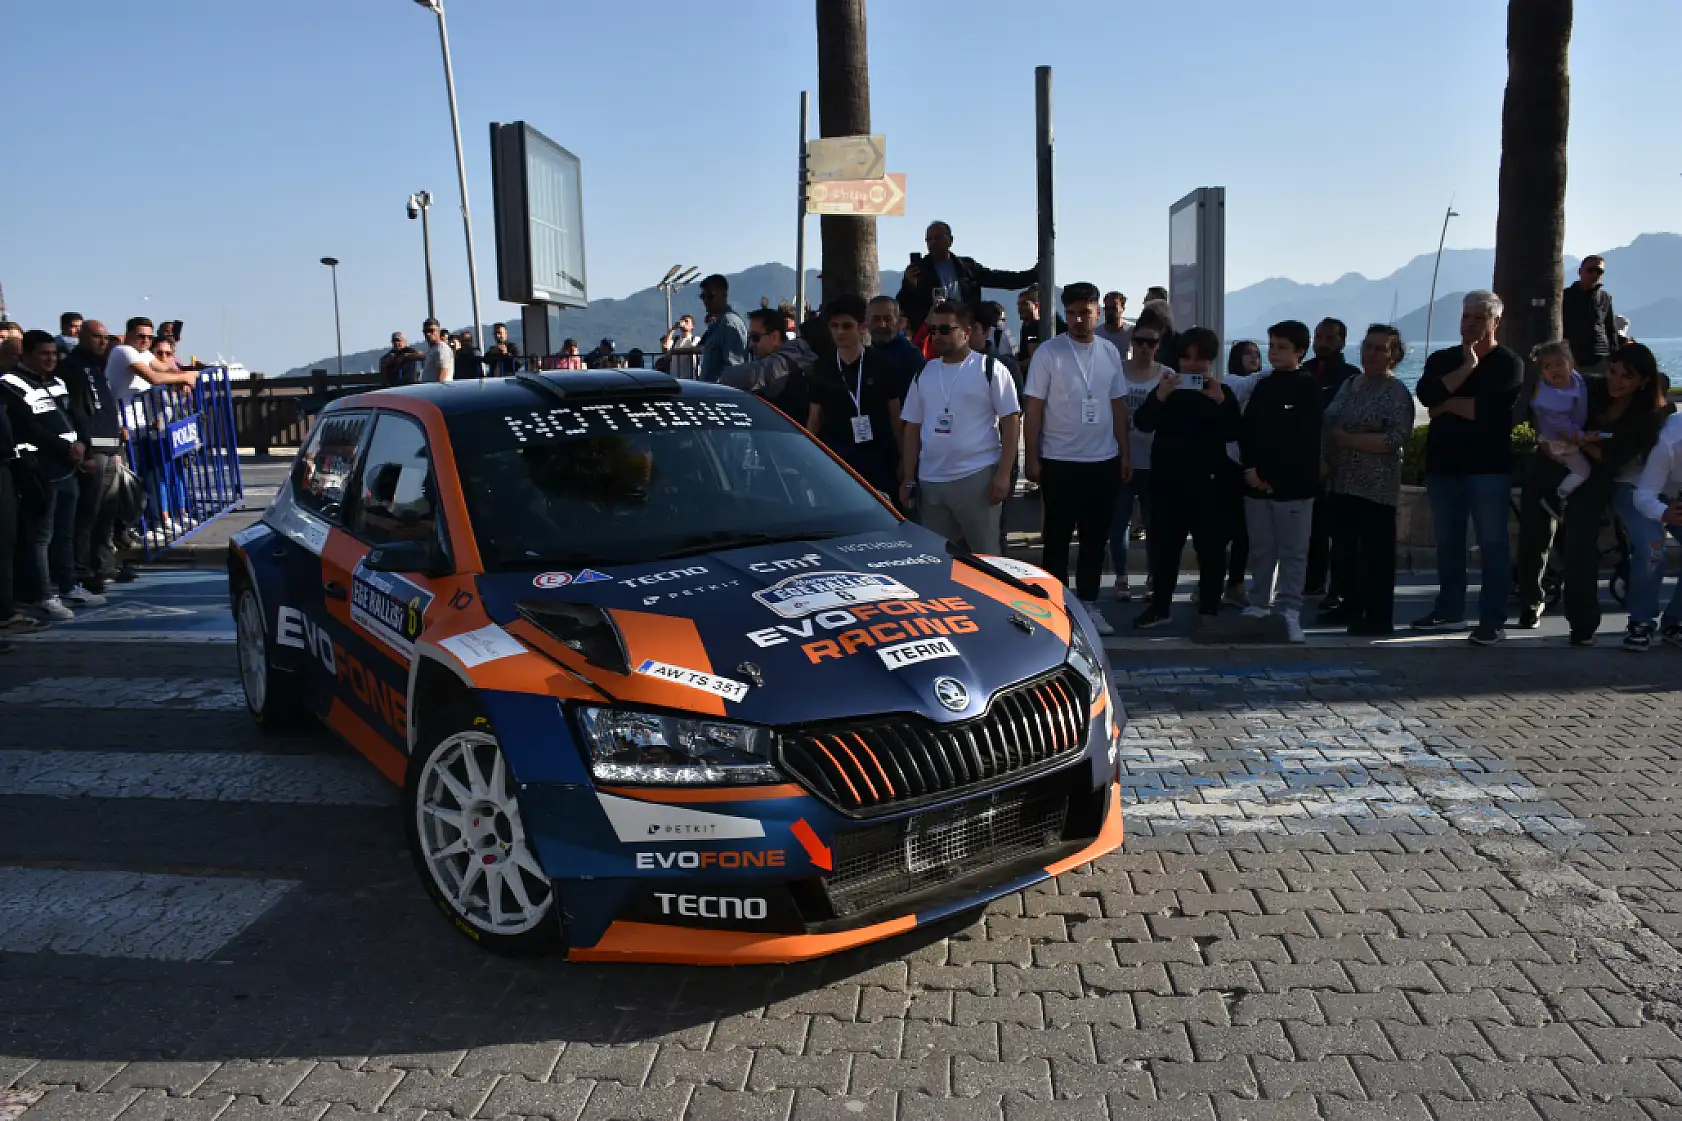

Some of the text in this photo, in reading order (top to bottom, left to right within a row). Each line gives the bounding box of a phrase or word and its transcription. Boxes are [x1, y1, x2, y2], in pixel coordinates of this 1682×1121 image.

[505, 402, 752, 442] NOTHING
[745, 596, 975, 648] EVOFONE
[800, 615, 980, 665] RACING
[886, 641, 950, 663] TEAM
[654, 665, 742, 696] AW TS 351
[664, 824, 716, 833] PETKIT
[635, 850, 785, 869] EVOFONE
[653, 892, 768, 919] TECNO
